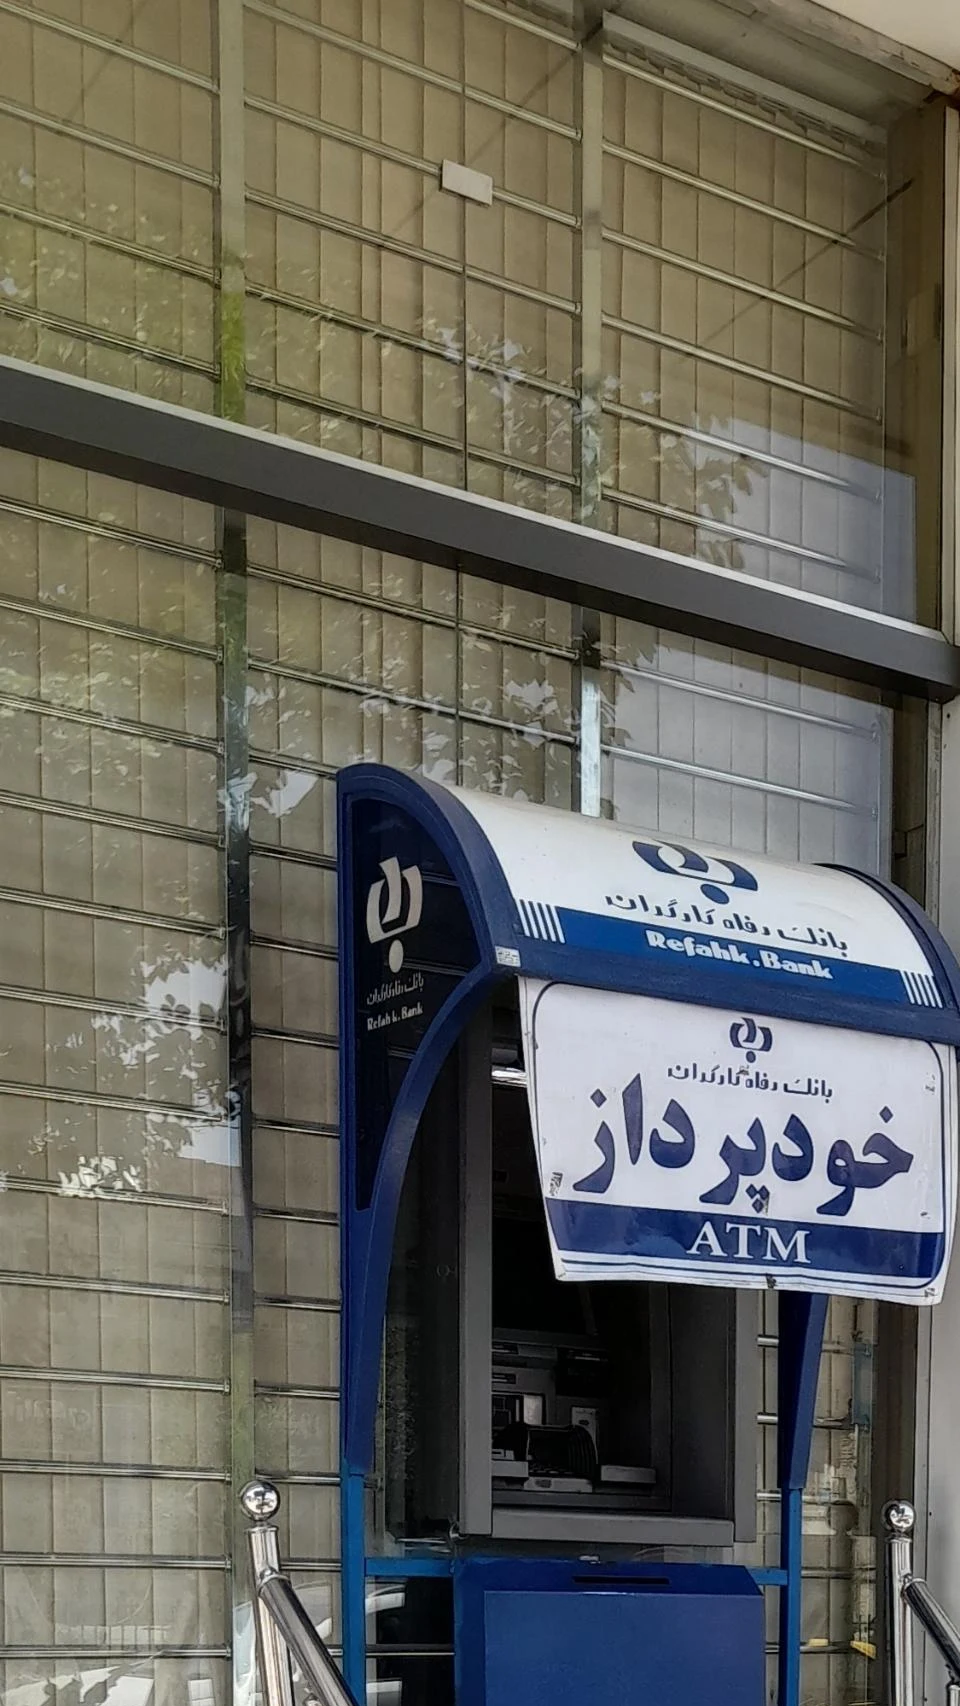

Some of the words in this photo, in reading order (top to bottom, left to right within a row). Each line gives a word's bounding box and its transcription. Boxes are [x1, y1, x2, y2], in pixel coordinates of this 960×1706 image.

[401, 1001, 424, 1020] Bank
[572, 1072, 914, 1216] خودپرداز
[686, 1220, 812, 1264] ATM
